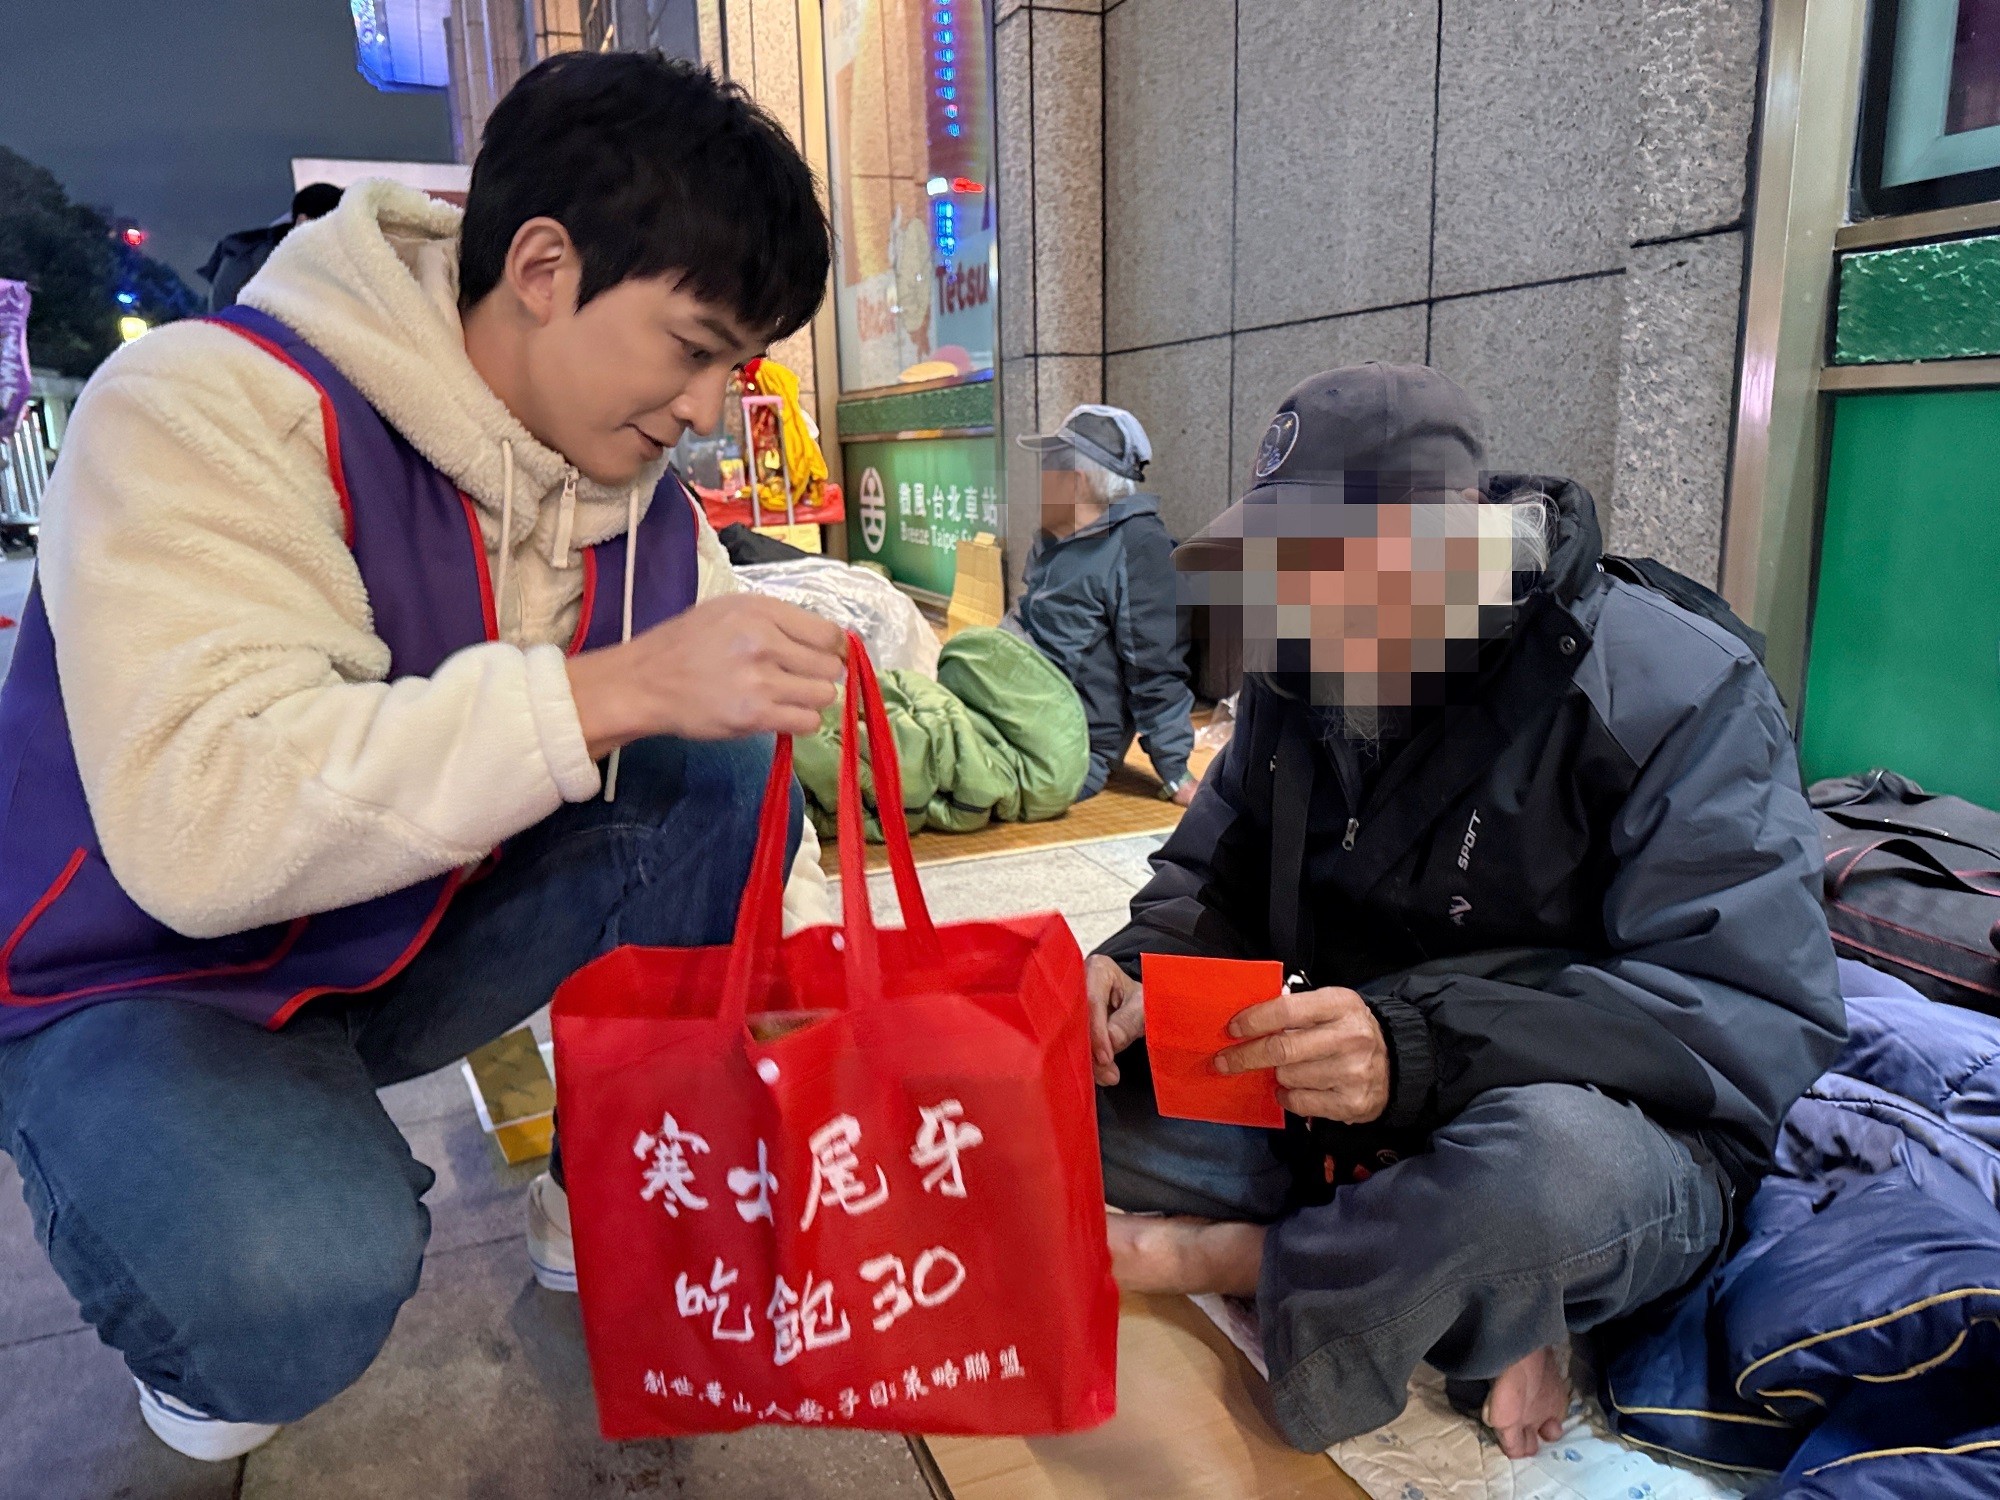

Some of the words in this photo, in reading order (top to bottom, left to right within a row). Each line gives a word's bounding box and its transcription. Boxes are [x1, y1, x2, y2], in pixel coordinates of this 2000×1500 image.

[935, 262, 989, 316] Tetsu
[1457, 808, 1481, 871] SPORT
[633, 1098, 984, 1232] 寒士尾牙
[674, 1244, 967, 1367] 吃飽30
